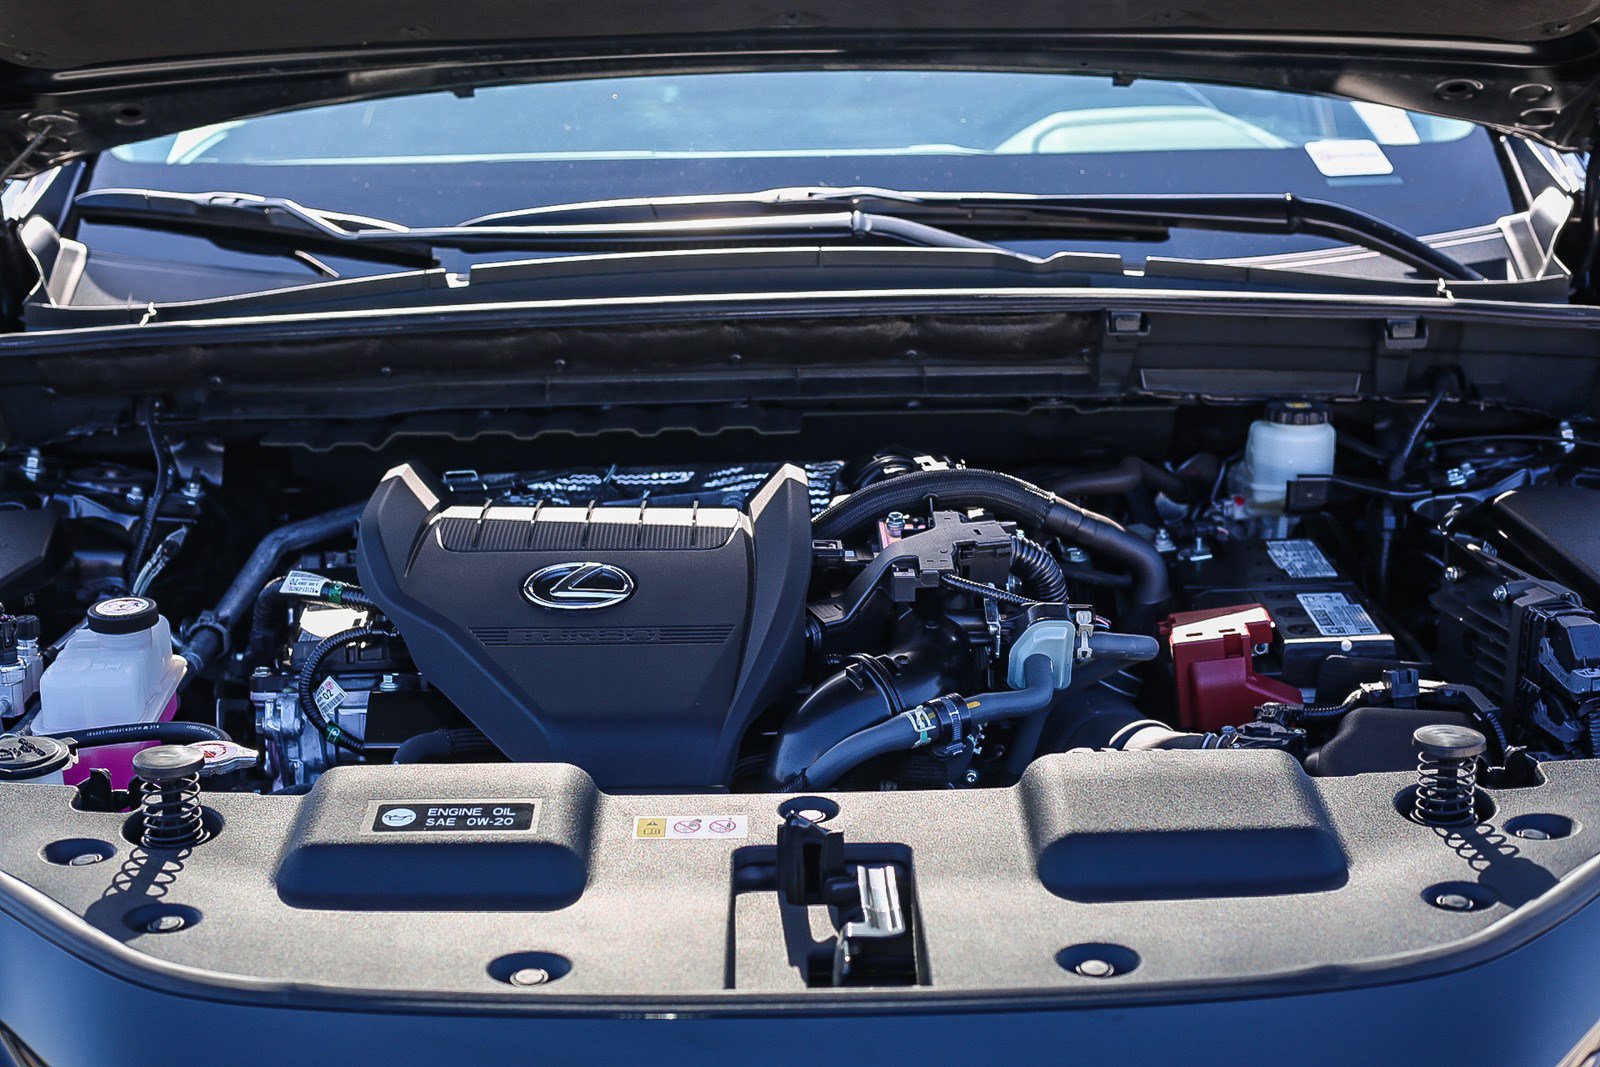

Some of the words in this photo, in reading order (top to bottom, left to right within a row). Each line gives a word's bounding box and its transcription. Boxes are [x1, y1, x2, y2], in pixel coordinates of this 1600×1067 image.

[509, 628, 658, 643] TURBO
[427, 807, 484, 816] ENGINE
[492, 807, 516, 816] OIL
[425, 817, 457, 826] SAE
[466, 817, 514, 826] 0W-20
